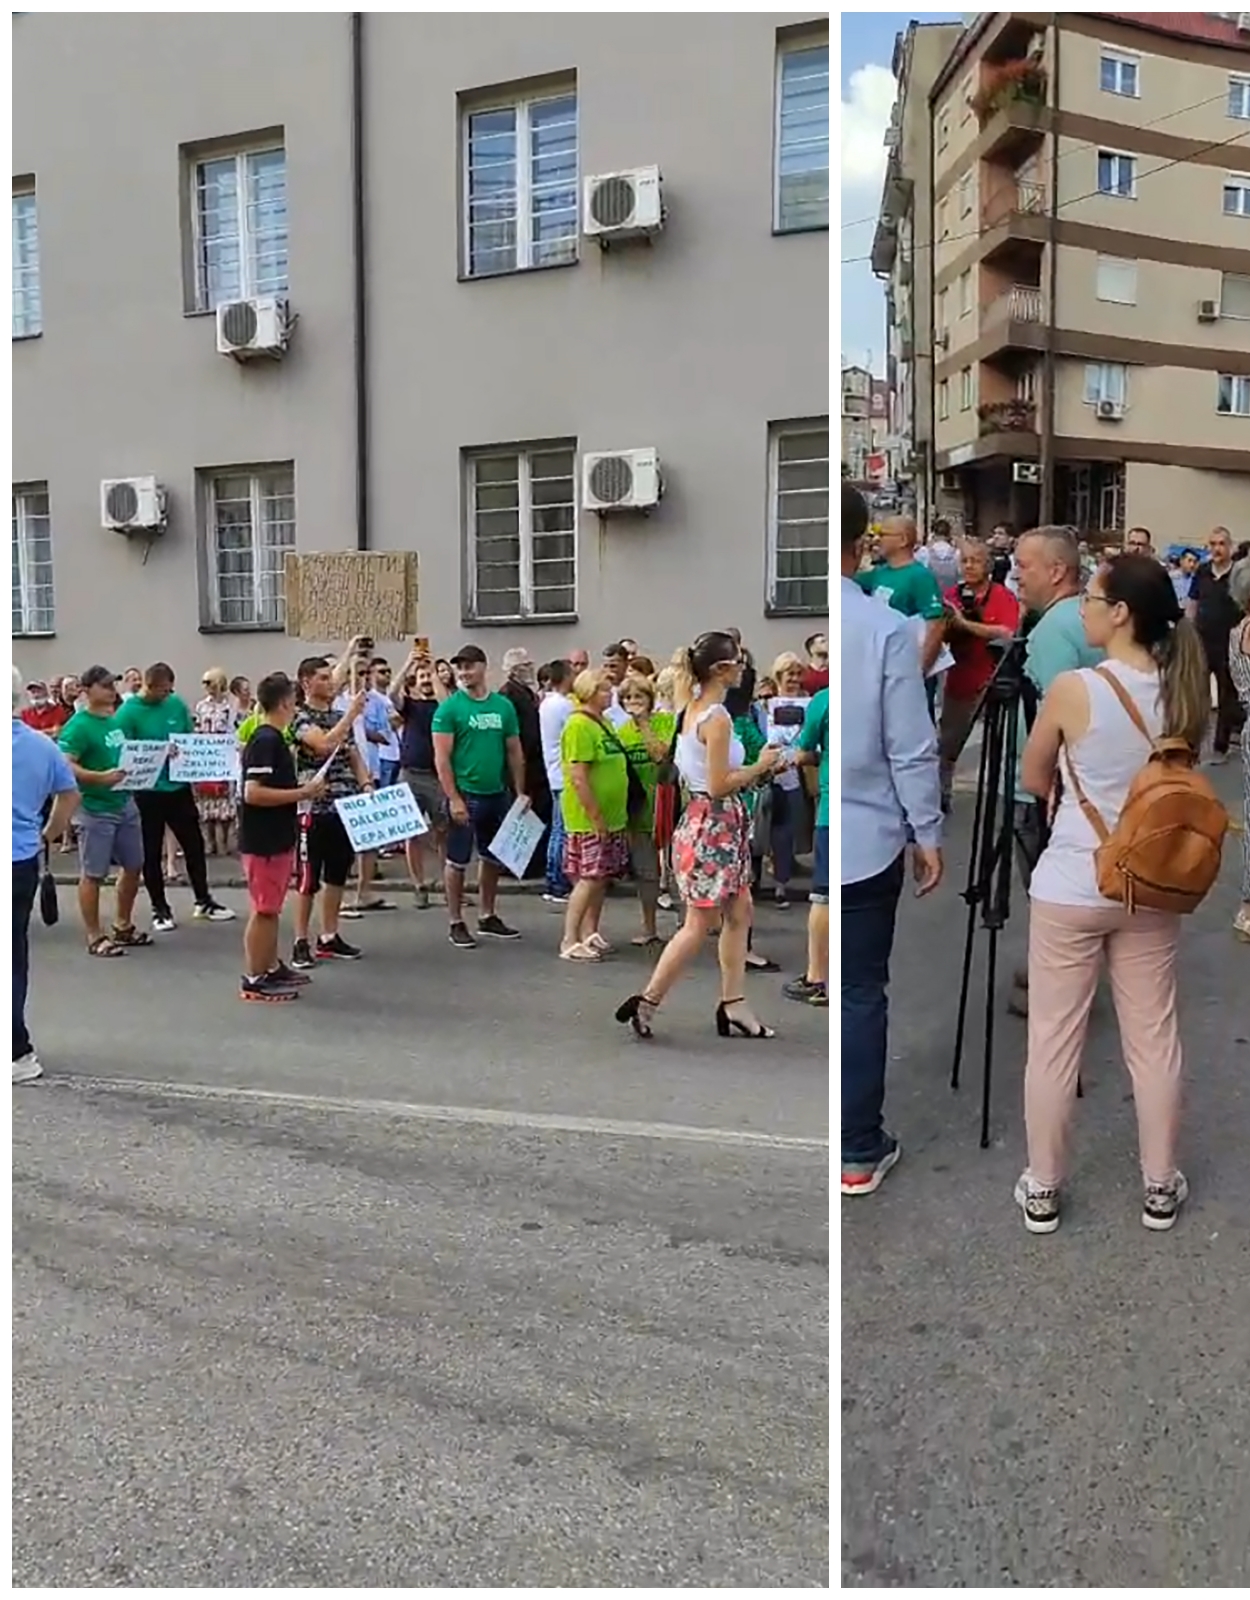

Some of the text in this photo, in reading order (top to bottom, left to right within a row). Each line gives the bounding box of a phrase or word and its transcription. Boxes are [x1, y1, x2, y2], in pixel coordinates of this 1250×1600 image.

[343, 788, 406, 811] RIO TINTO
[349, 806, 399, 828] DALEKO
[353, 830, 386, 846] LEPA
